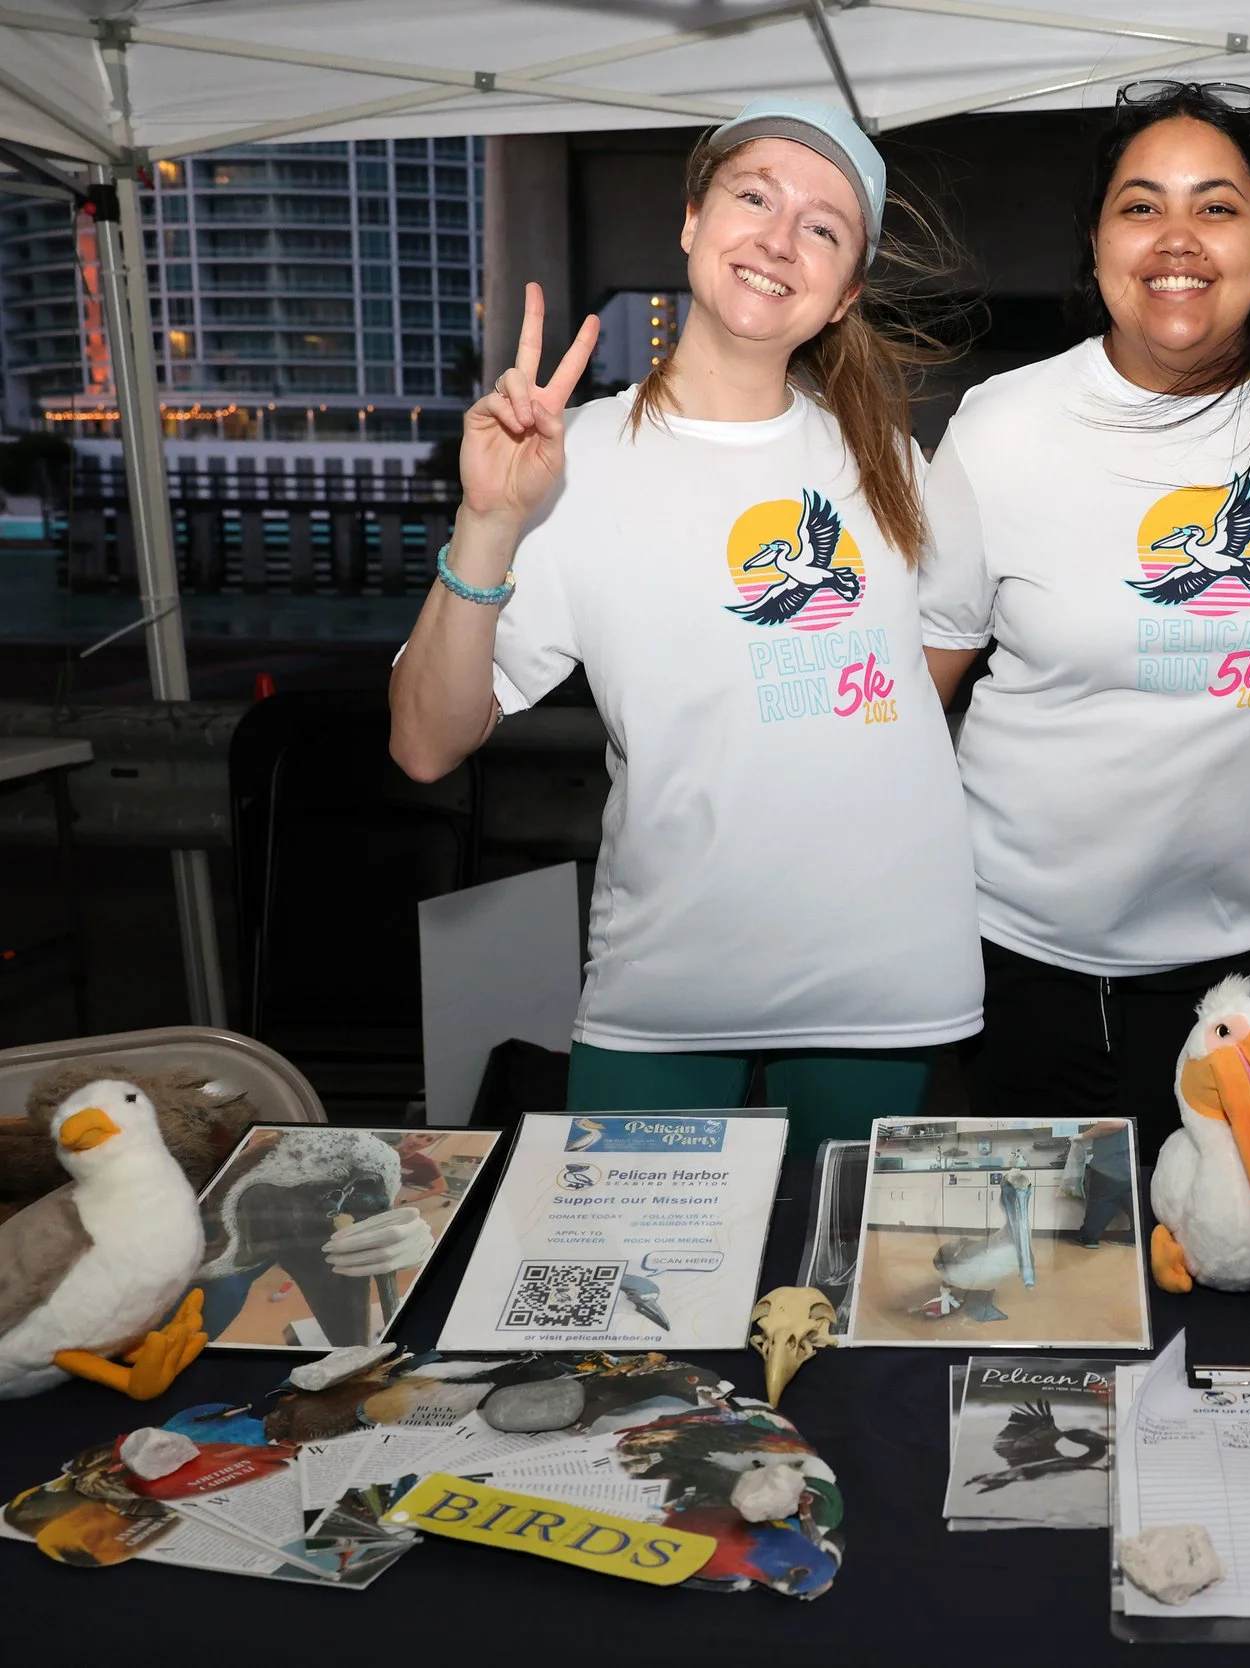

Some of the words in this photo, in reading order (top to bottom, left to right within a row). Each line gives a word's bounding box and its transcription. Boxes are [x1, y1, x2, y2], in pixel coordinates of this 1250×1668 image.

[749, 629, 890, 679] PELICAN
[1138, 657, 1209, 692] RUN
[757, 677, 832, 723] RUN
[833, 652, 894, 717] 5k
[863, 699, 899, 724] 2025
[624, 1120, 696, 1134] Pelican
[662, 1133, 720, 1147] Party
[607, 1169, 667, 1180] Pelican
[672, 1169, 730, 1180] Harbor
[552, 1196, 616, 1206] Support
[652, 1196, 719, 1204] Mission!
[565, 1334, 662, 1342] pelicanharbor.org
[982, 1367, 1078, 1385] Pelican
[1083, 1371, 1108, 1387] Pr
[397, 1419, 454, 1427] CHICKADE
[411, 1412, 457, 1420] CAPPED
[417, 1489, 682, 1569] BIRDS
